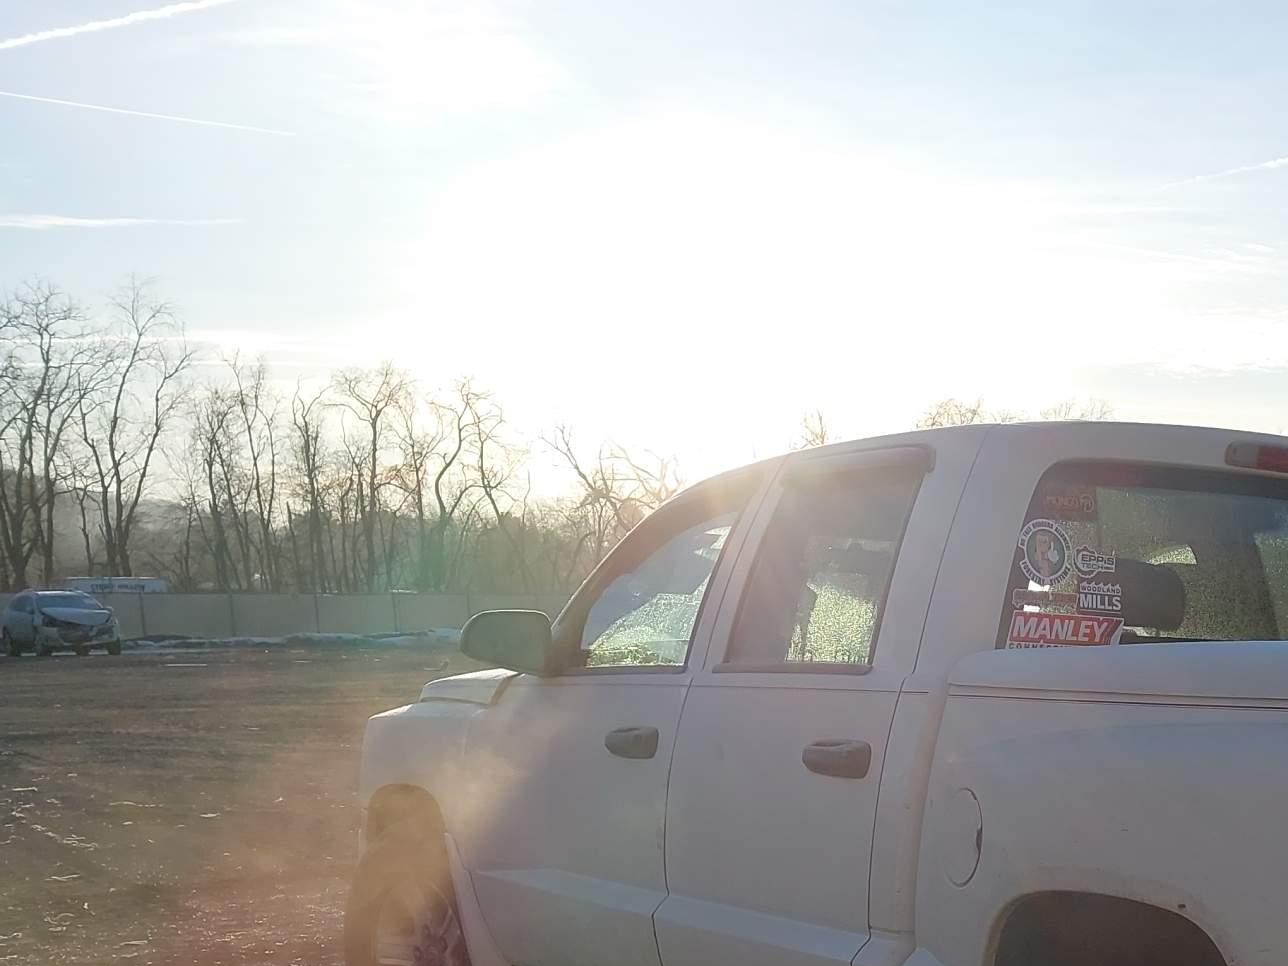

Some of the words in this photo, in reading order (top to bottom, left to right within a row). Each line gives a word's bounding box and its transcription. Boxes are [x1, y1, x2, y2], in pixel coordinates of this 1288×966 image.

[1080, 584, 1120, 594] WOODLAND
[1080, 594, 1121, 610] MILLS
[1013, 616, 1109, 642] MANLEY
